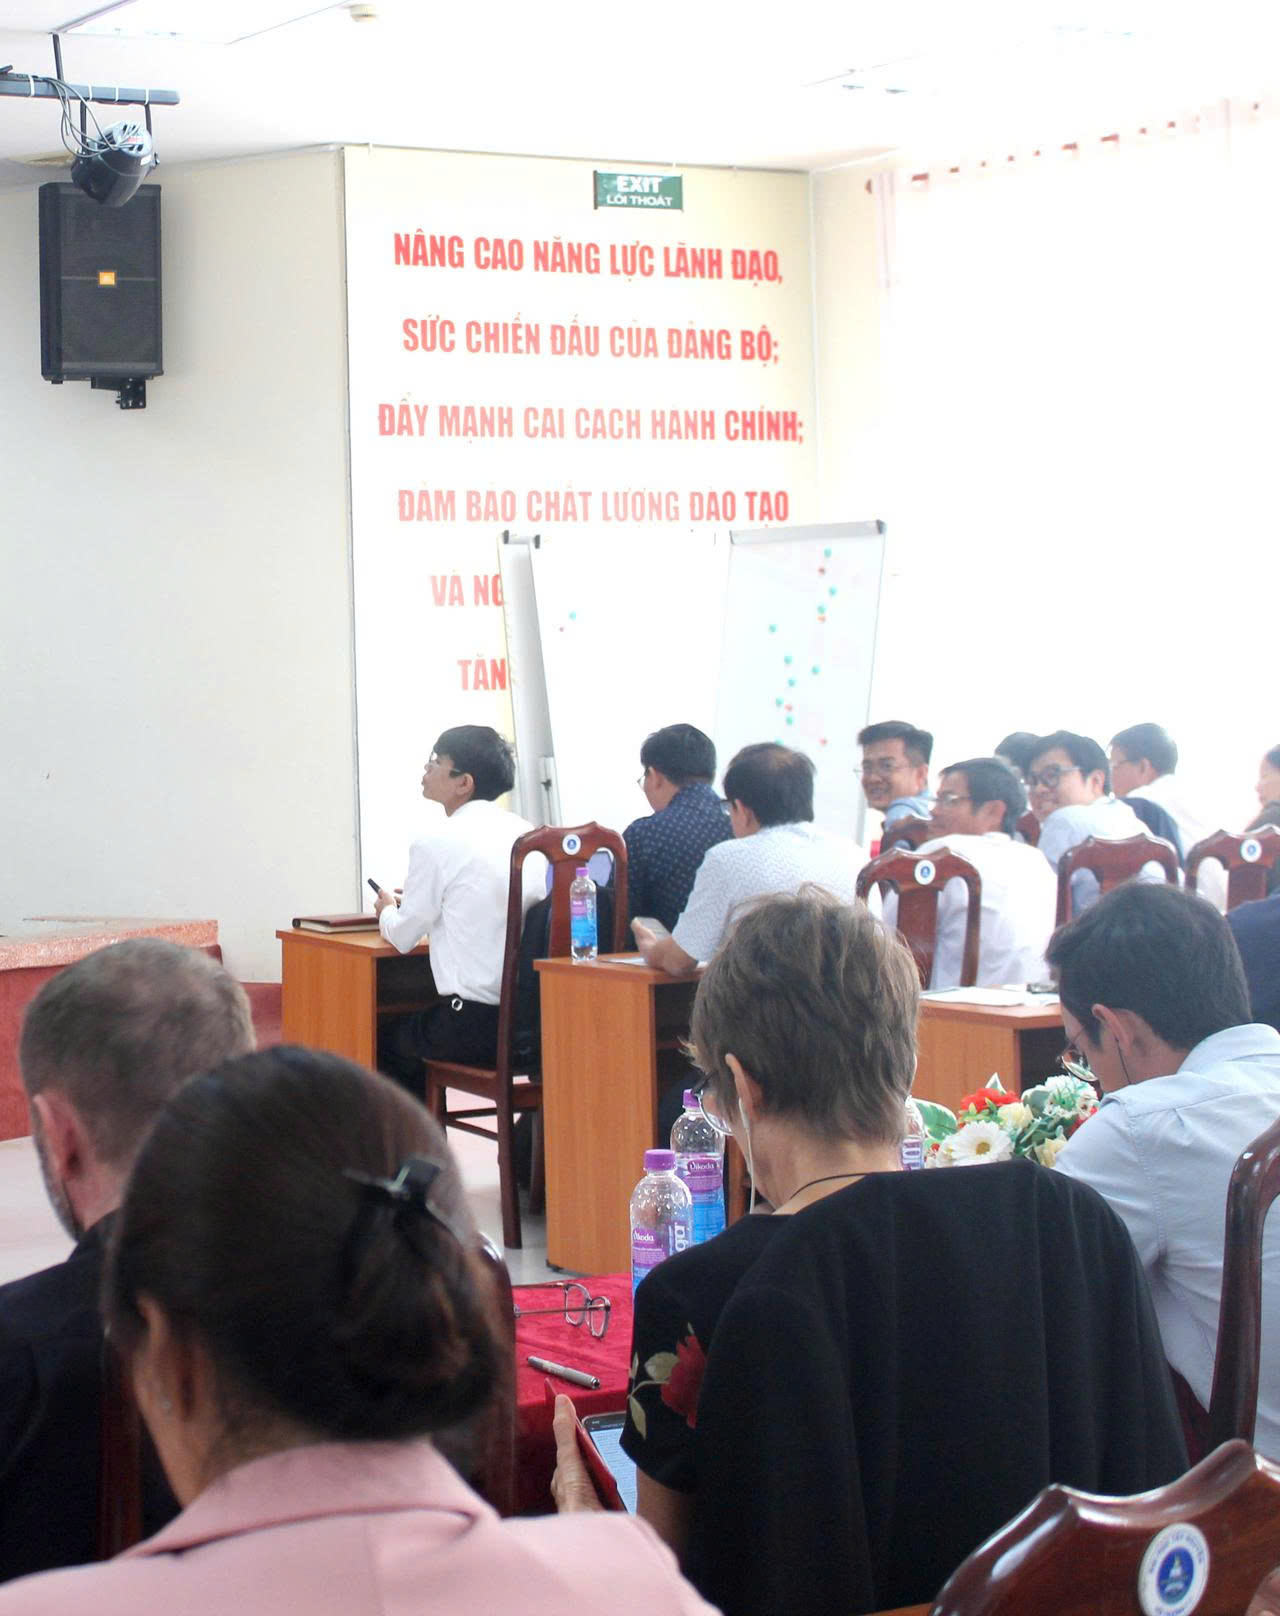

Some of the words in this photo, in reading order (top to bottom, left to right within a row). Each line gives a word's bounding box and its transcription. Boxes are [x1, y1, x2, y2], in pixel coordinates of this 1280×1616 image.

[616, 175, 663, 193] EXIT
[393, 228, 465, 269] NÂNG
[473, 236, 525, 272] CAO
[532, 236, 601, 275] NĂNG
[609, 240, 655, 281] LỰC
[402, 313, 456, 352] SỨC
[457, 652, 511, 692] TĂN
